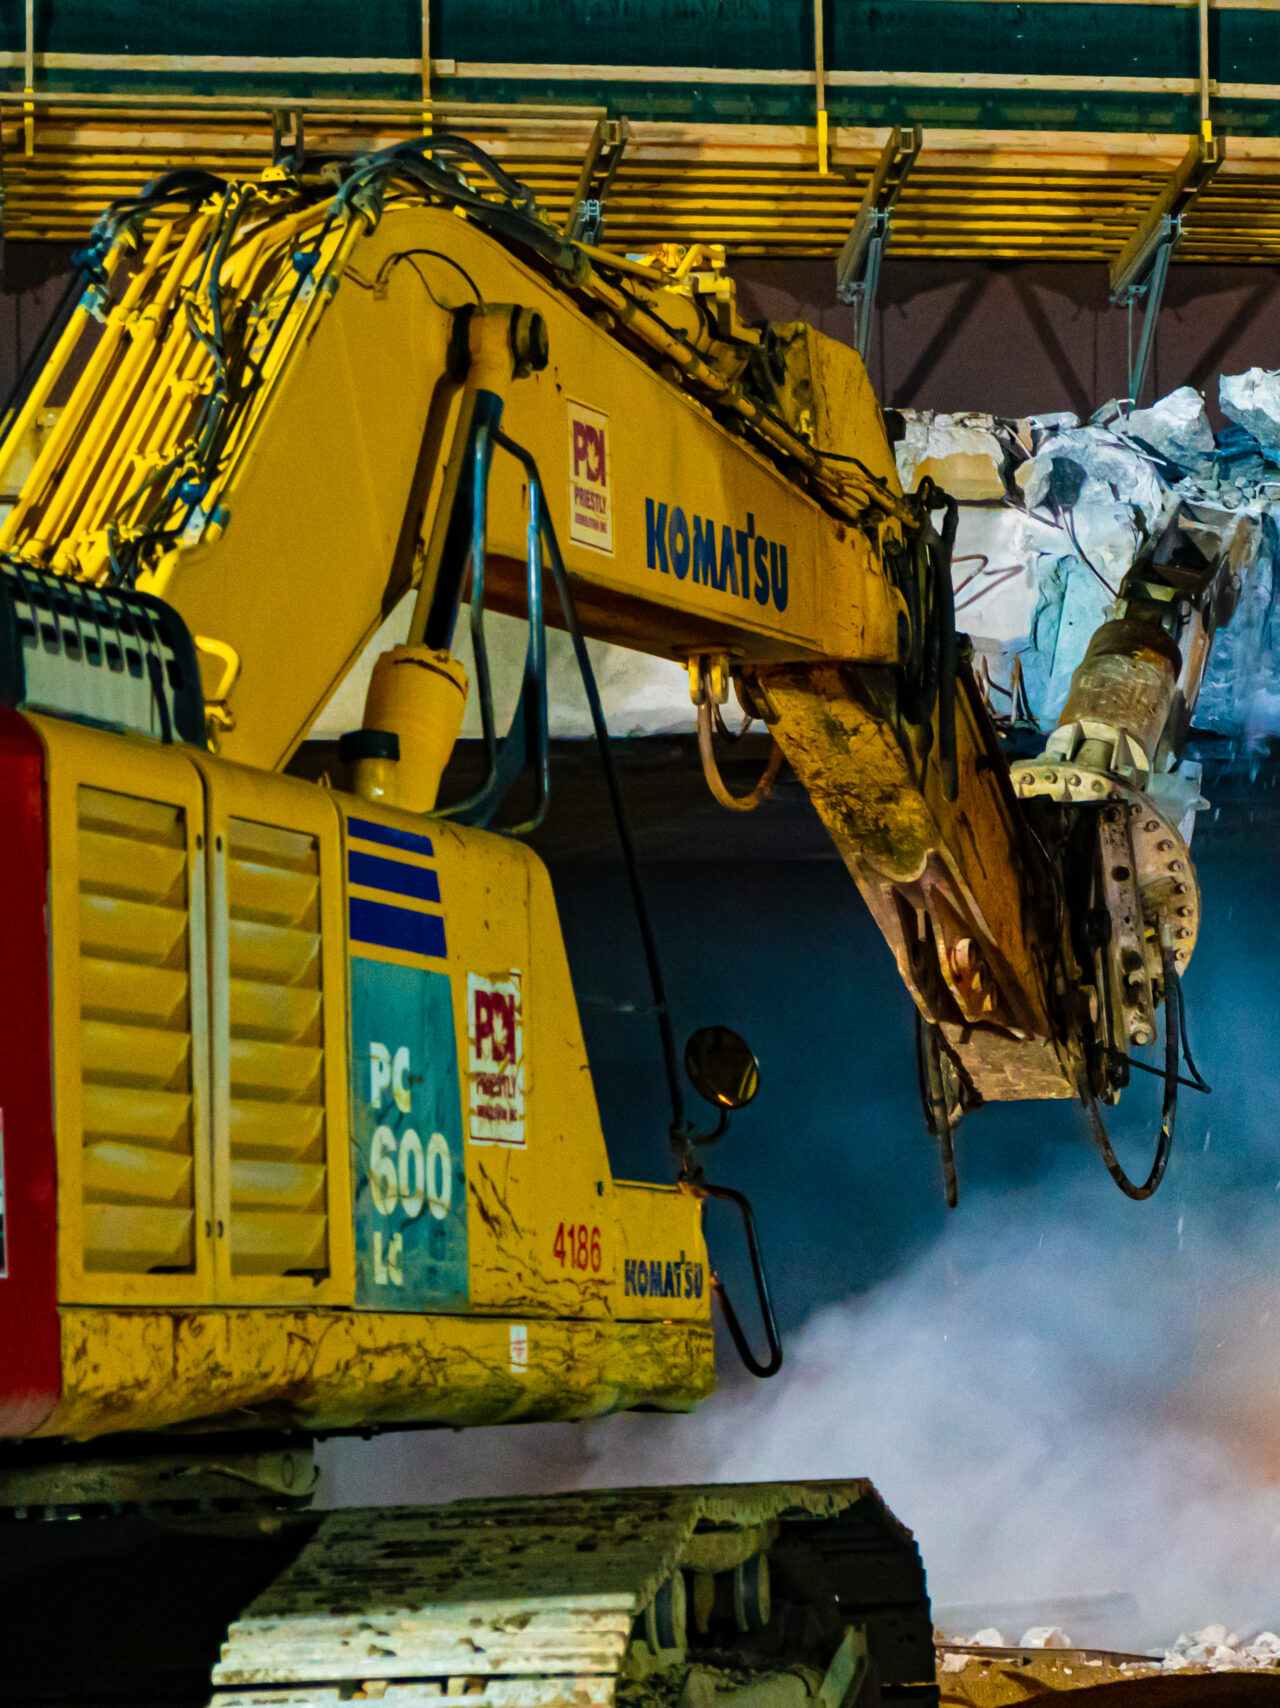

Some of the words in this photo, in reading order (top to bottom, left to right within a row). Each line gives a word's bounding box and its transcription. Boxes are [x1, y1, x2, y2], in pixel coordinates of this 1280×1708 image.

[573, 420, 606, 487] PDI
[645, 497, 788, 612] KOMATSU
[475, 989, 516, 1065] PDI
[369, 1042, 411, 1113] PC
[370, 1125, 452, 1220] 600
[373, 1232, 404, 1286] LC
[553, 1222, 601, 1273] 4186
[625, 1250, 703, 1299] KOMATSU
